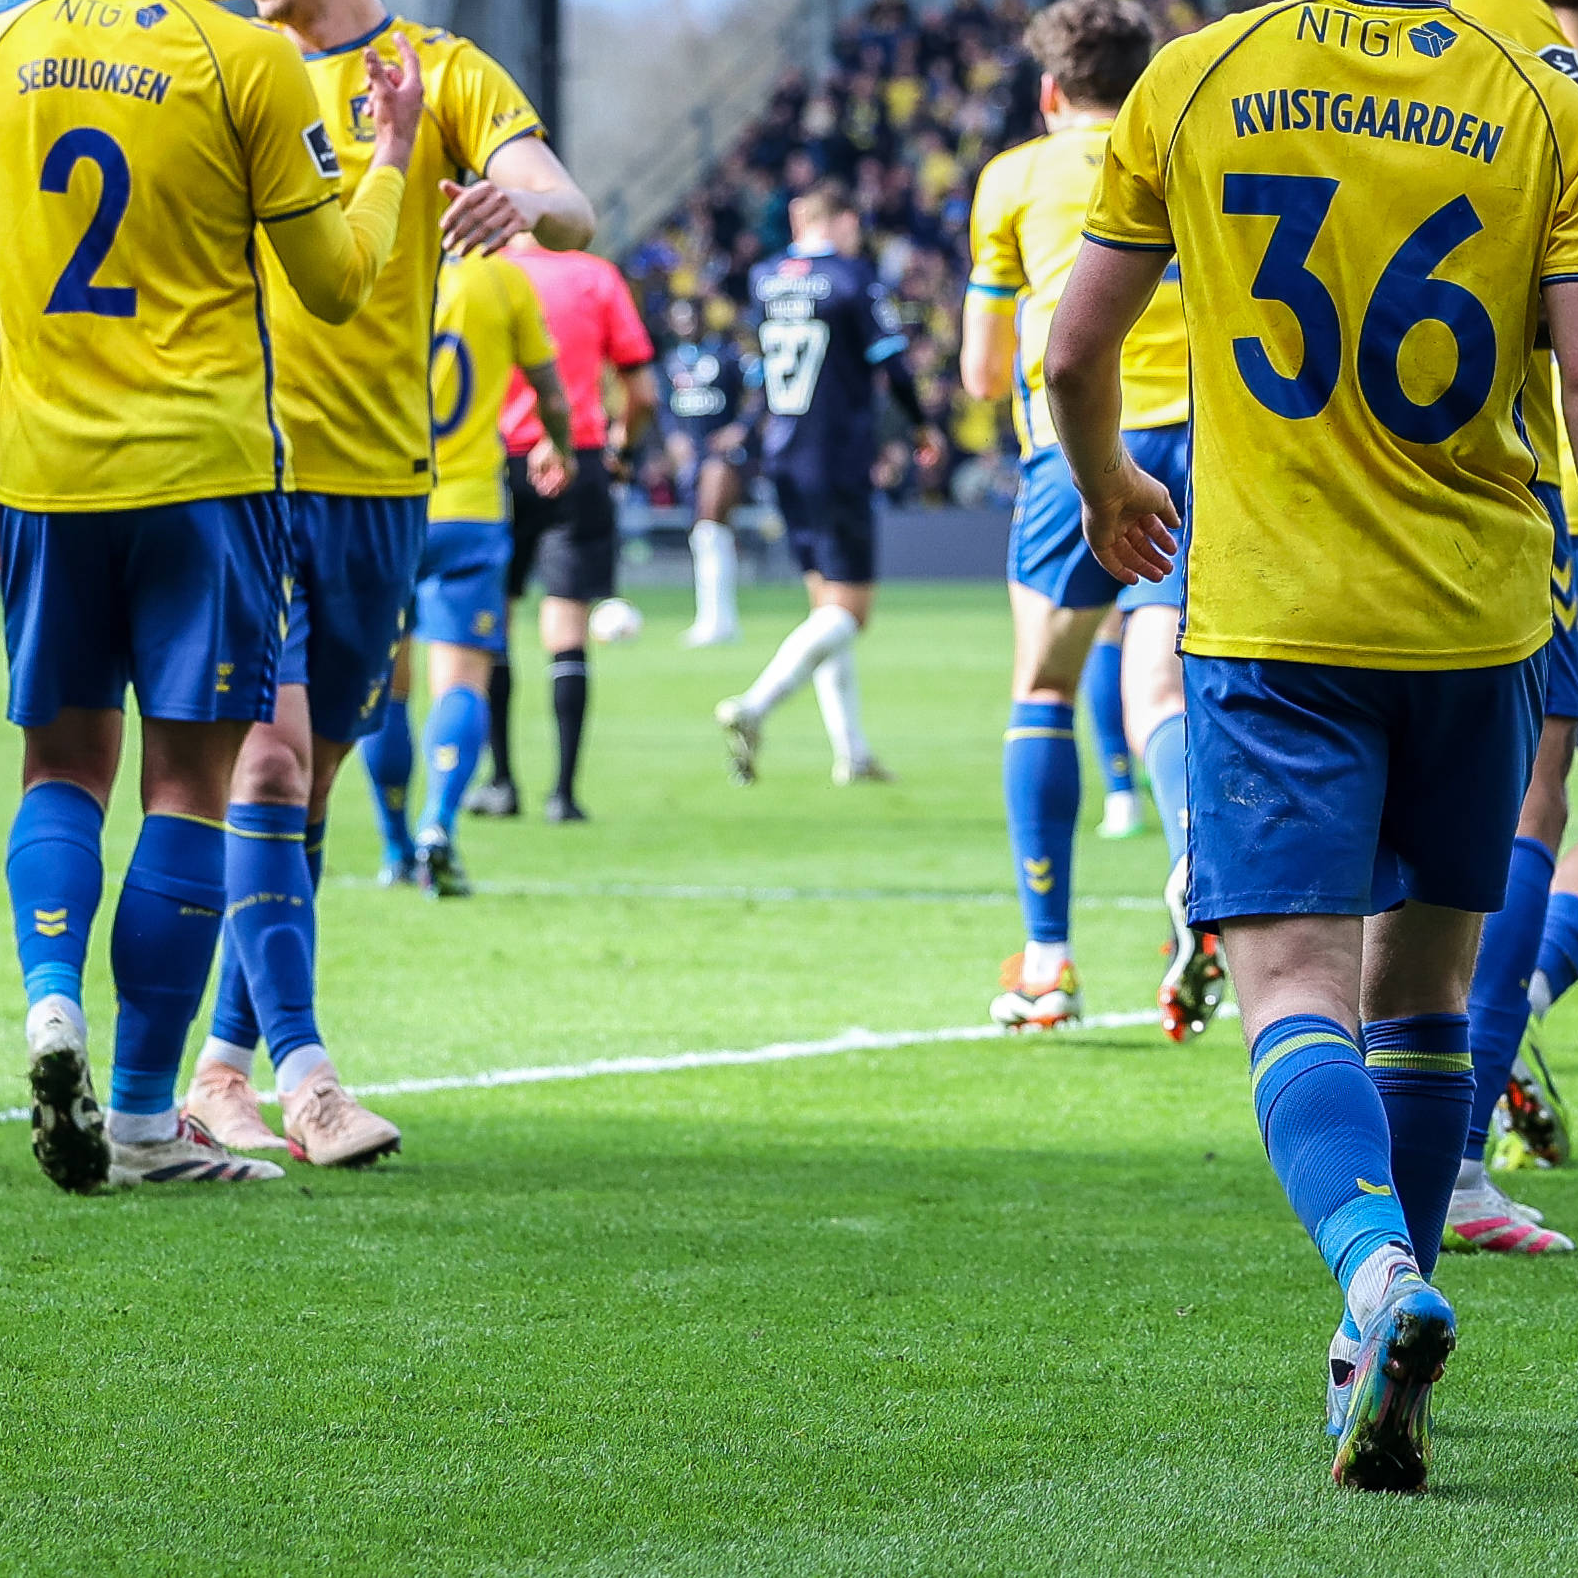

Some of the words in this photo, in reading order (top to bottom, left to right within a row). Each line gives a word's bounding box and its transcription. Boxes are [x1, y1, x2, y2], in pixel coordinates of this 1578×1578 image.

[1296, 5, 1391, 58] NTG
[17, 57, 172, 105] SEBULONSEN
[1231, 87, 1505, 165] KVISTGAARDEN
[39, 127, 138, 318] 2
[1222, 172, 1497, 445] 36
